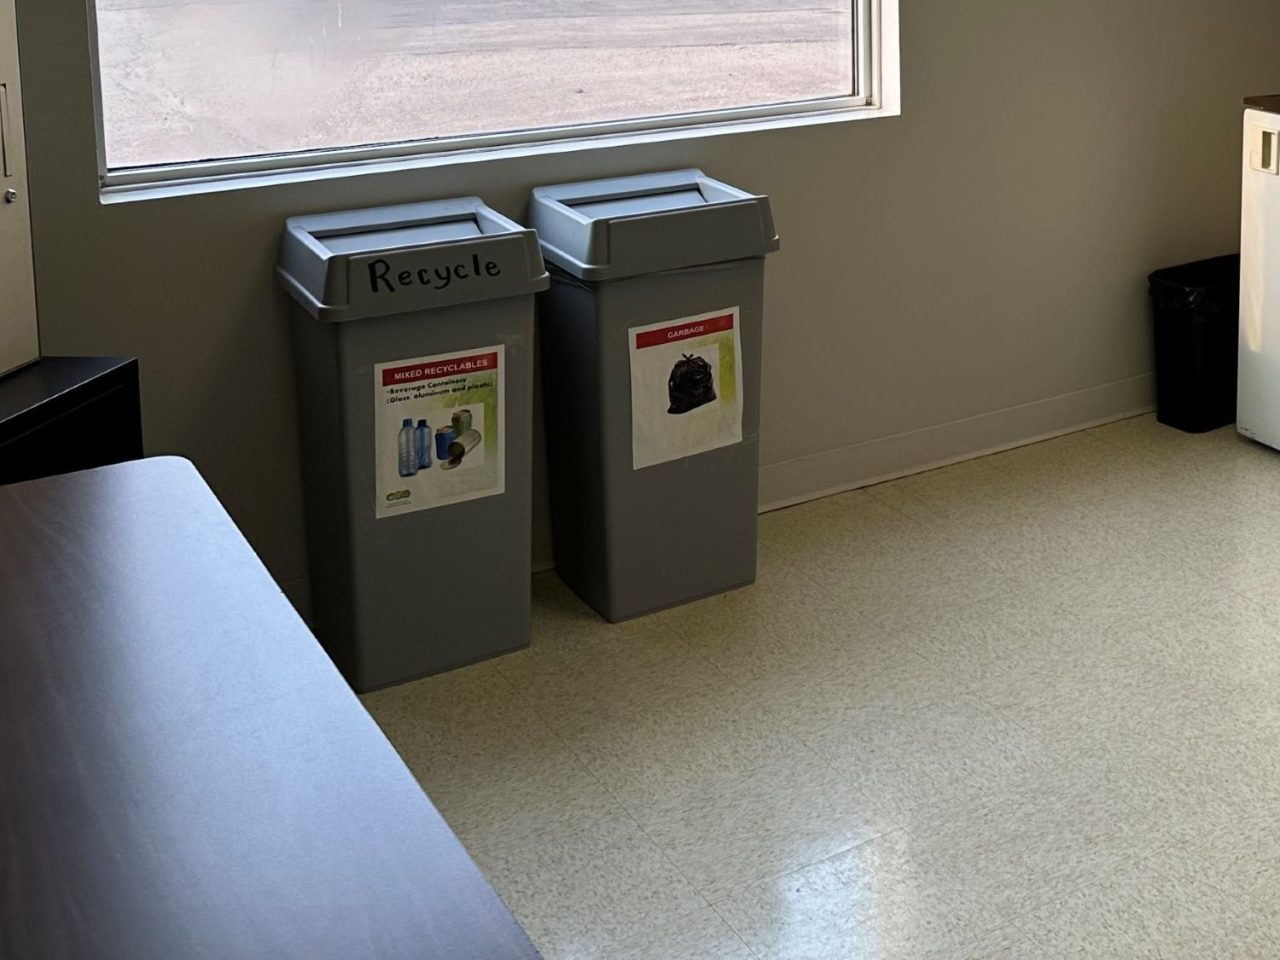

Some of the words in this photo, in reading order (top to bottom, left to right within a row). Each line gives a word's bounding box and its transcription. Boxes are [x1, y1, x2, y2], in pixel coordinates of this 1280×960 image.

[367, 254, 501, 293] Recycle
[667, 325, 705, 338] GARBAGE
[394, 369, 423, 380] MIXED
[424, 359, 488, 375] RECYCLABLES
[451, 384, 466, 393] and
